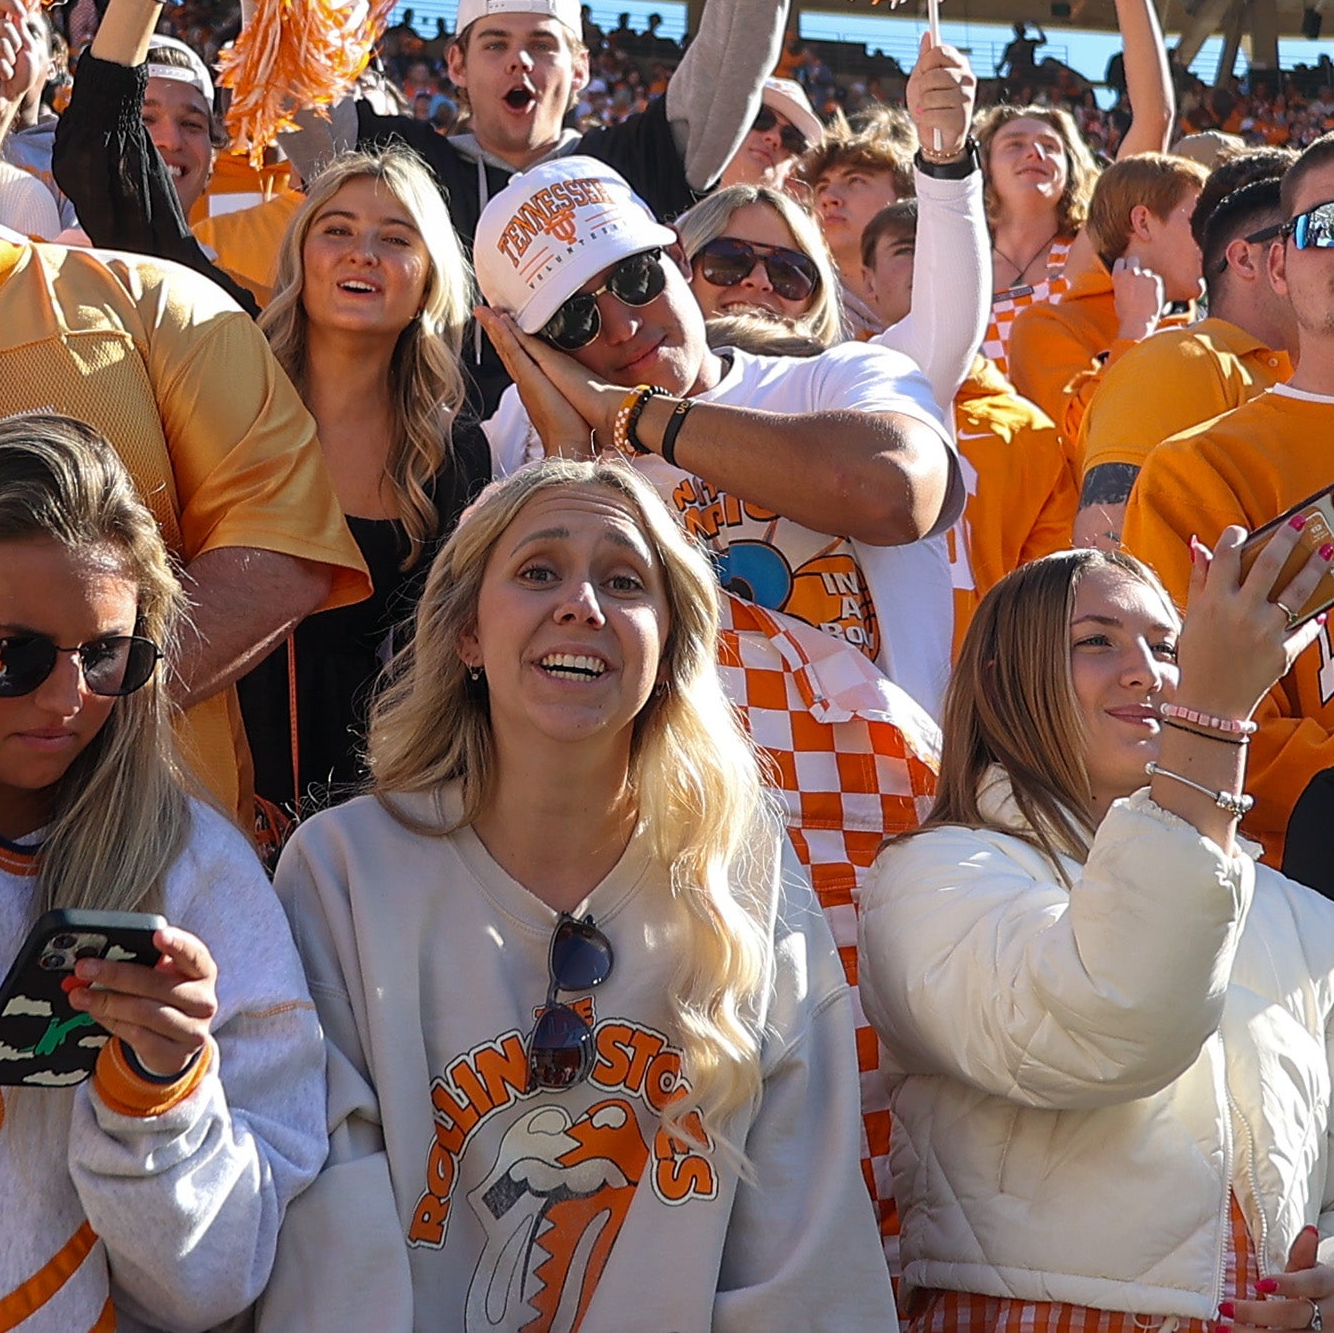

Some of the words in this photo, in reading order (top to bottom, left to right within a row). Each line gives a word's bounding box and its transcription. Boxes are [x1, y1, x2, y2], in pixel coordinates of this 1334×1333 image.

[497, 177, 617, 269] TENNESSEE
[528, 220, 629, 290] VOLUNTEE
[820, 571, 859, 596] IN
[840, 597, 862, 620] A
[407, 1028, 537, 1250] ROLLIN
[586, 1016, 719, 1207] STOES
